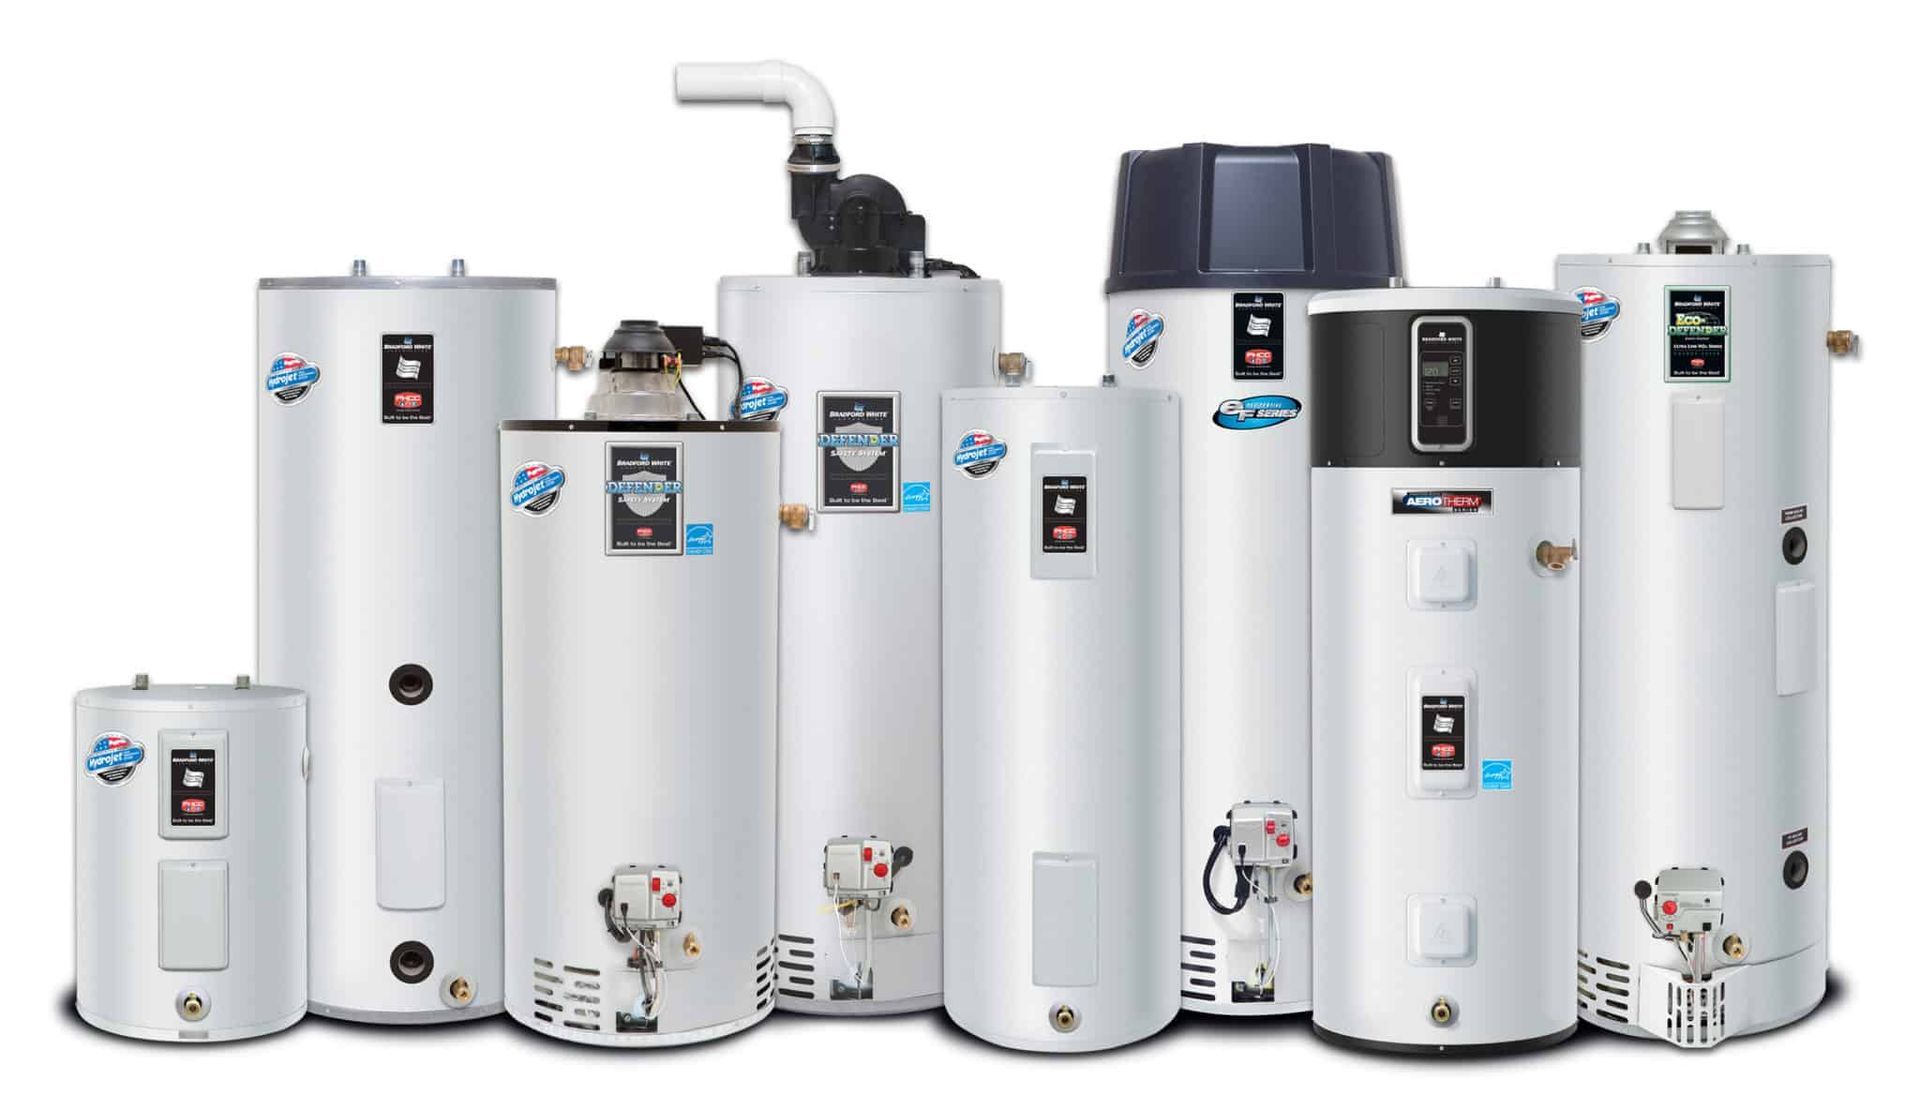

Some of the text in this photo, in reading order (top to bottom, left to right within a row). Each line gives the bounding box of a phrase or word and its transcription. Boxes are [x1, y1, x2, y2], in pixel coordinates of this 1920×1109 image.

[1667, 325, 1728, 336] DEFENDER
[1255, 408, 1297, 418] SERIES
[818, 433, 899, 447] DEFENDER
[512, 480, 545, 503] Hydrojet
[606, 480, 683, 494] DEFENDER
[88, 752, 123, 769] Hydrojet
